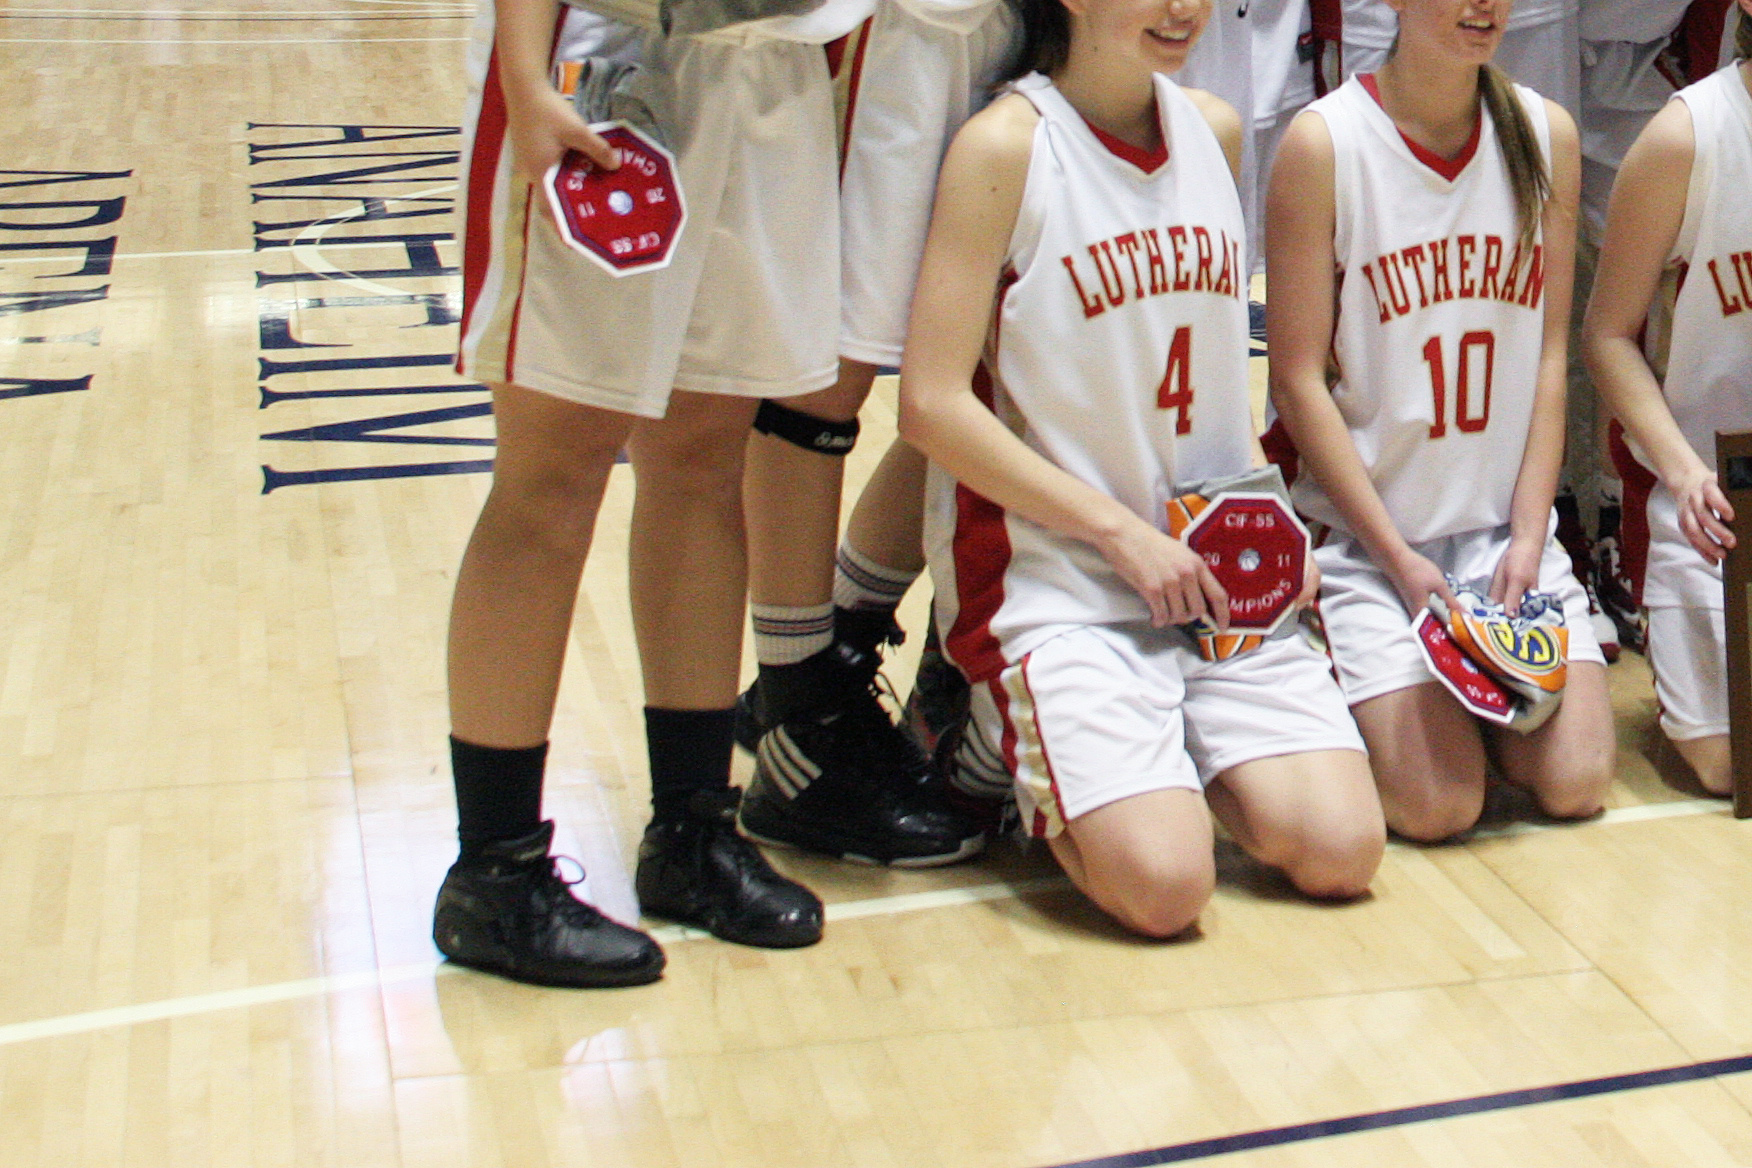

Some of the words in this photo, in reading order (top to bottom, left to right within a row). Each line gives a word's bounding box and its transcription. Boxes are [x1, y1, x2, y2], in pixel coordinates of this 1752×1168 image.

[246, 120, 497, 496] ANAHEIM
[1157, 325, 1194, 436] 4
[1422, 330, 1495, 439] 10
